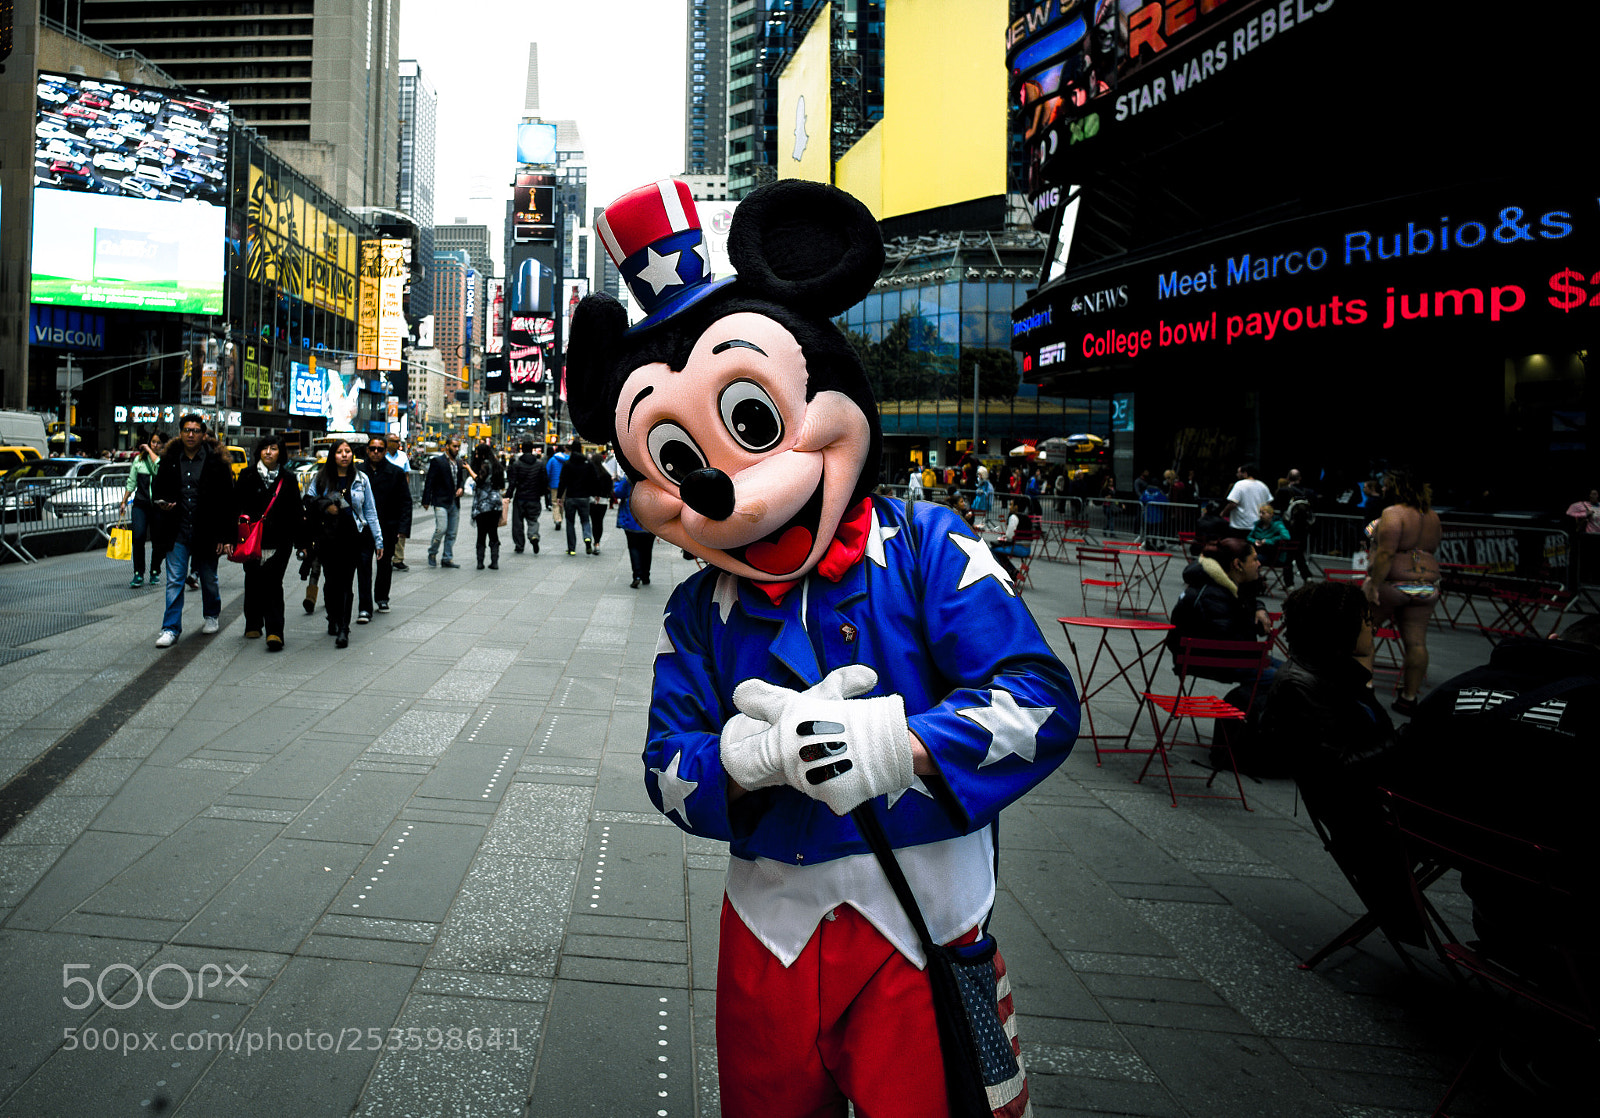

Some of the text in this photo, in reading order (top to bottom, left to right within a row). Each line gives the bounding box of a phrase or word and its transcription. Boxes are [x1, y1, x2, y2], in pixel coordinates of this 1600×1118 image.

[1115, 76, 1166, 121] STAR
[1171, 41, 1228, 95] WARS
[306, 246, 353, 300] LION KING
[1158, 206, 1573, 300] Meet Marco Rubio&s
[1082, 329, 1152, 358] College
[1159, 311, 1217, 347] bowl
[1226, 295, 1368, 345] payouts
[1383, 285, 1526, 329] jump
[1083, 285, 1129, 316] NEWS
[35, 324, 102, 347] VIACOM
[1039, 341, 1066, 367] ESPN
[1474, 536, 1520, 566] BOYS
